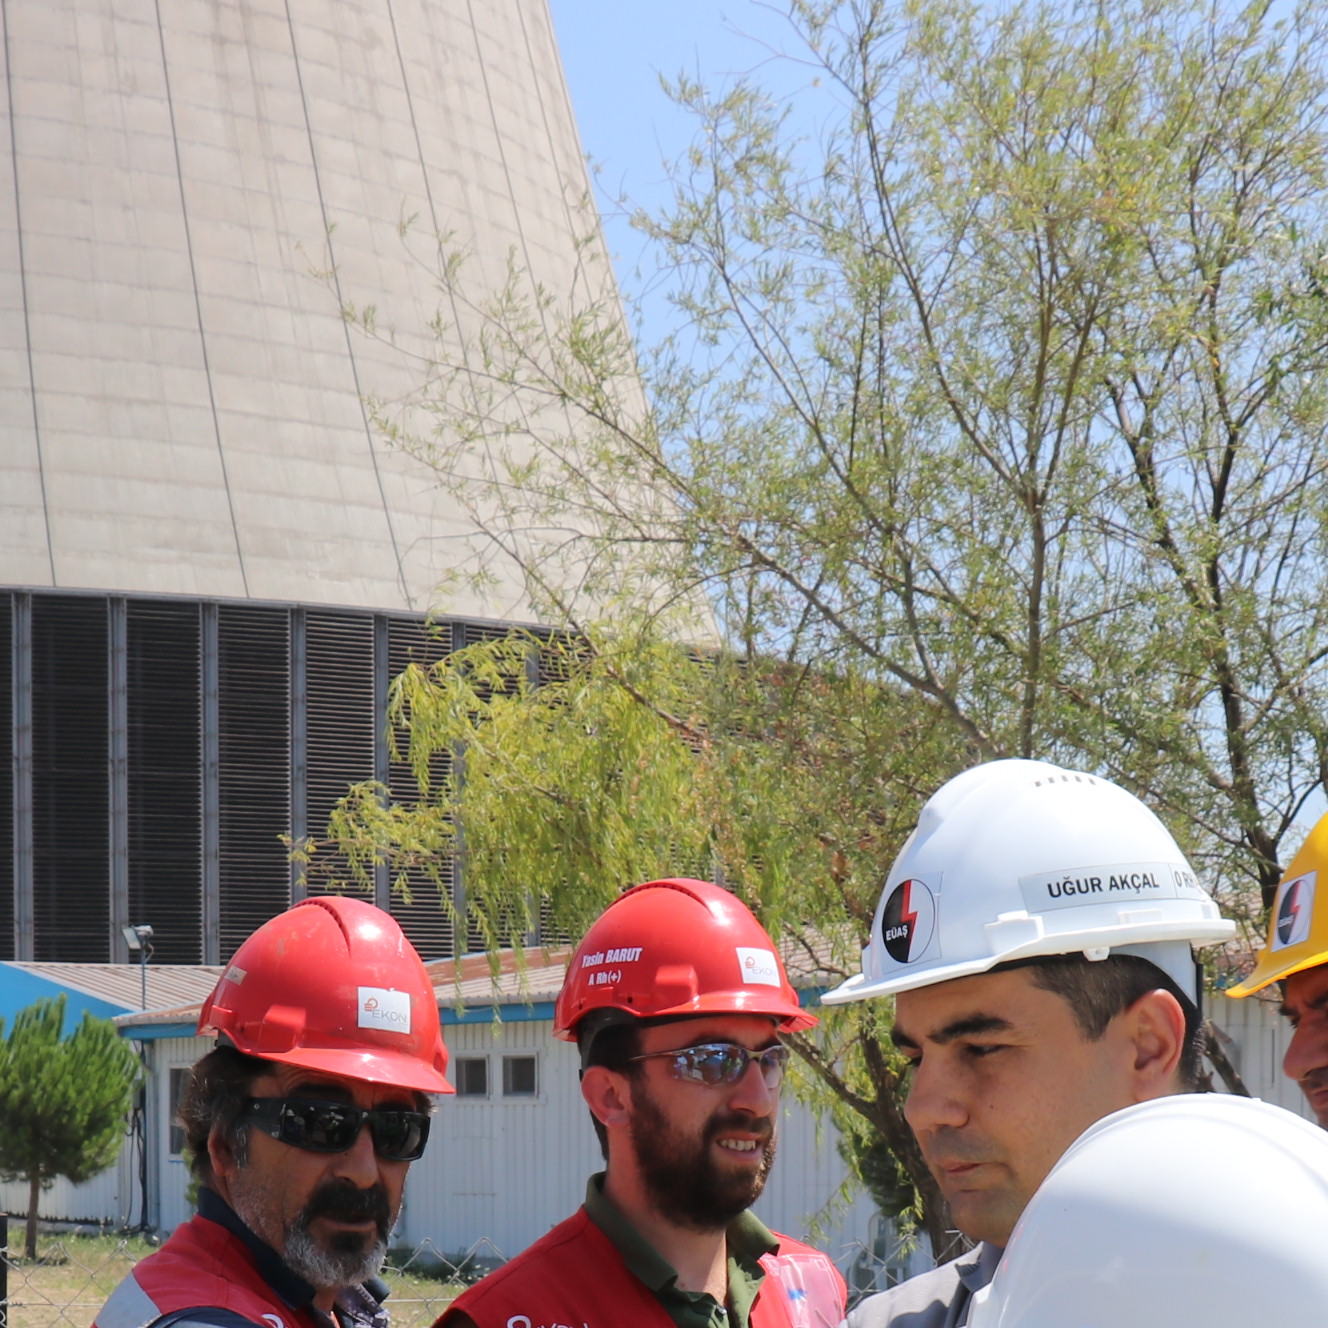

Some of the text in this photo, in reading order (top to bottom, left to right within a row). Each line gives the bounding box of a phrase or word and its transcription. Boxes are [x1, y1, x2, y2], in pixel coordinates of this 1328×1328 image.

[1047, 872, 1160, 899] UĞUR AKÇAL
[885, 924, 909, 943] EÜAŞ
[582, 947, 643, 968] Yasin BARUT
[588, 973, 595, 985] A
[372, 1011, 407, 1023] EKON
